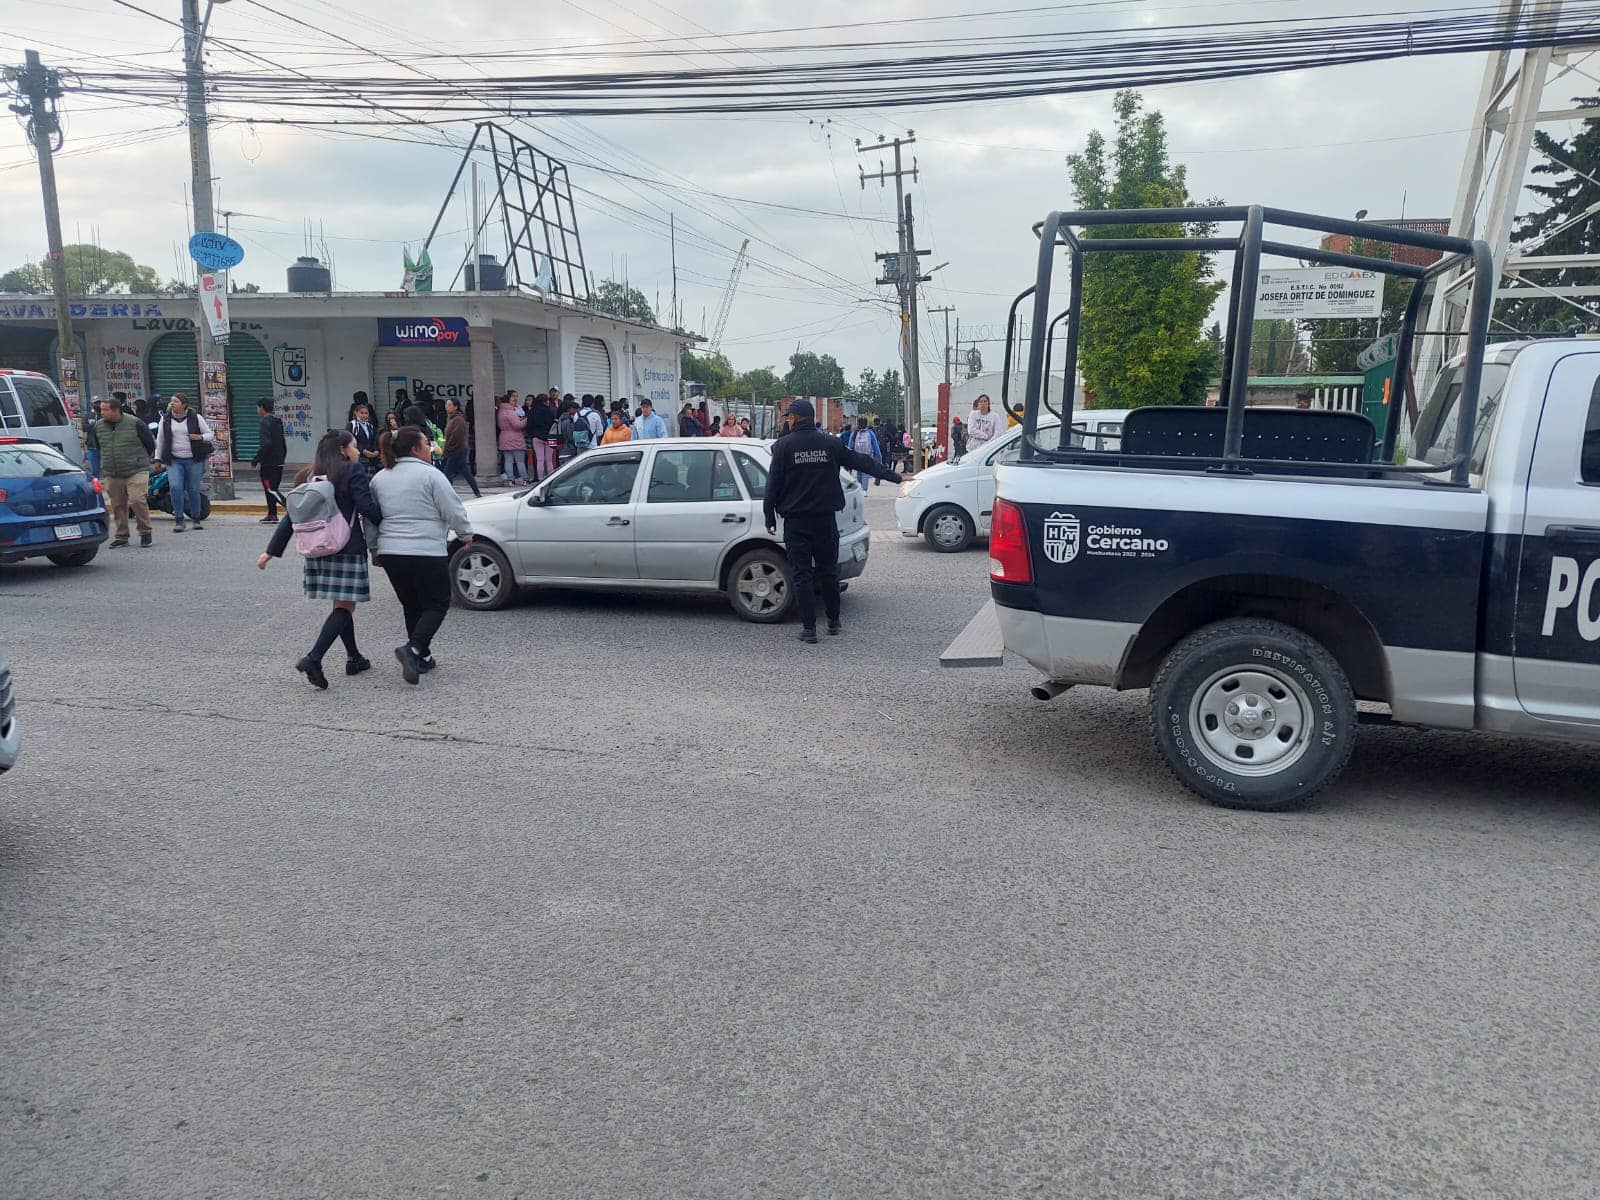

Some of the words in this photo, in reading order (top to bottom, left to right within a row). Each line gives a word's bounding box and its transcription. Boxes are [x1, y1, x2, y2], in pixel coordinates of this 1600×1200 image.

[1291, 292, 1313, 300] ORTIZ
[1328, 290, 1375, 299] DOMINGUEZ
[437, 332, 458, 342] pay
[1088, 525, 1142, 536] Gobierno
[1087, 535, 1169, 551] Cercano
[1252, 648, 1332, 715] DESTINATION
